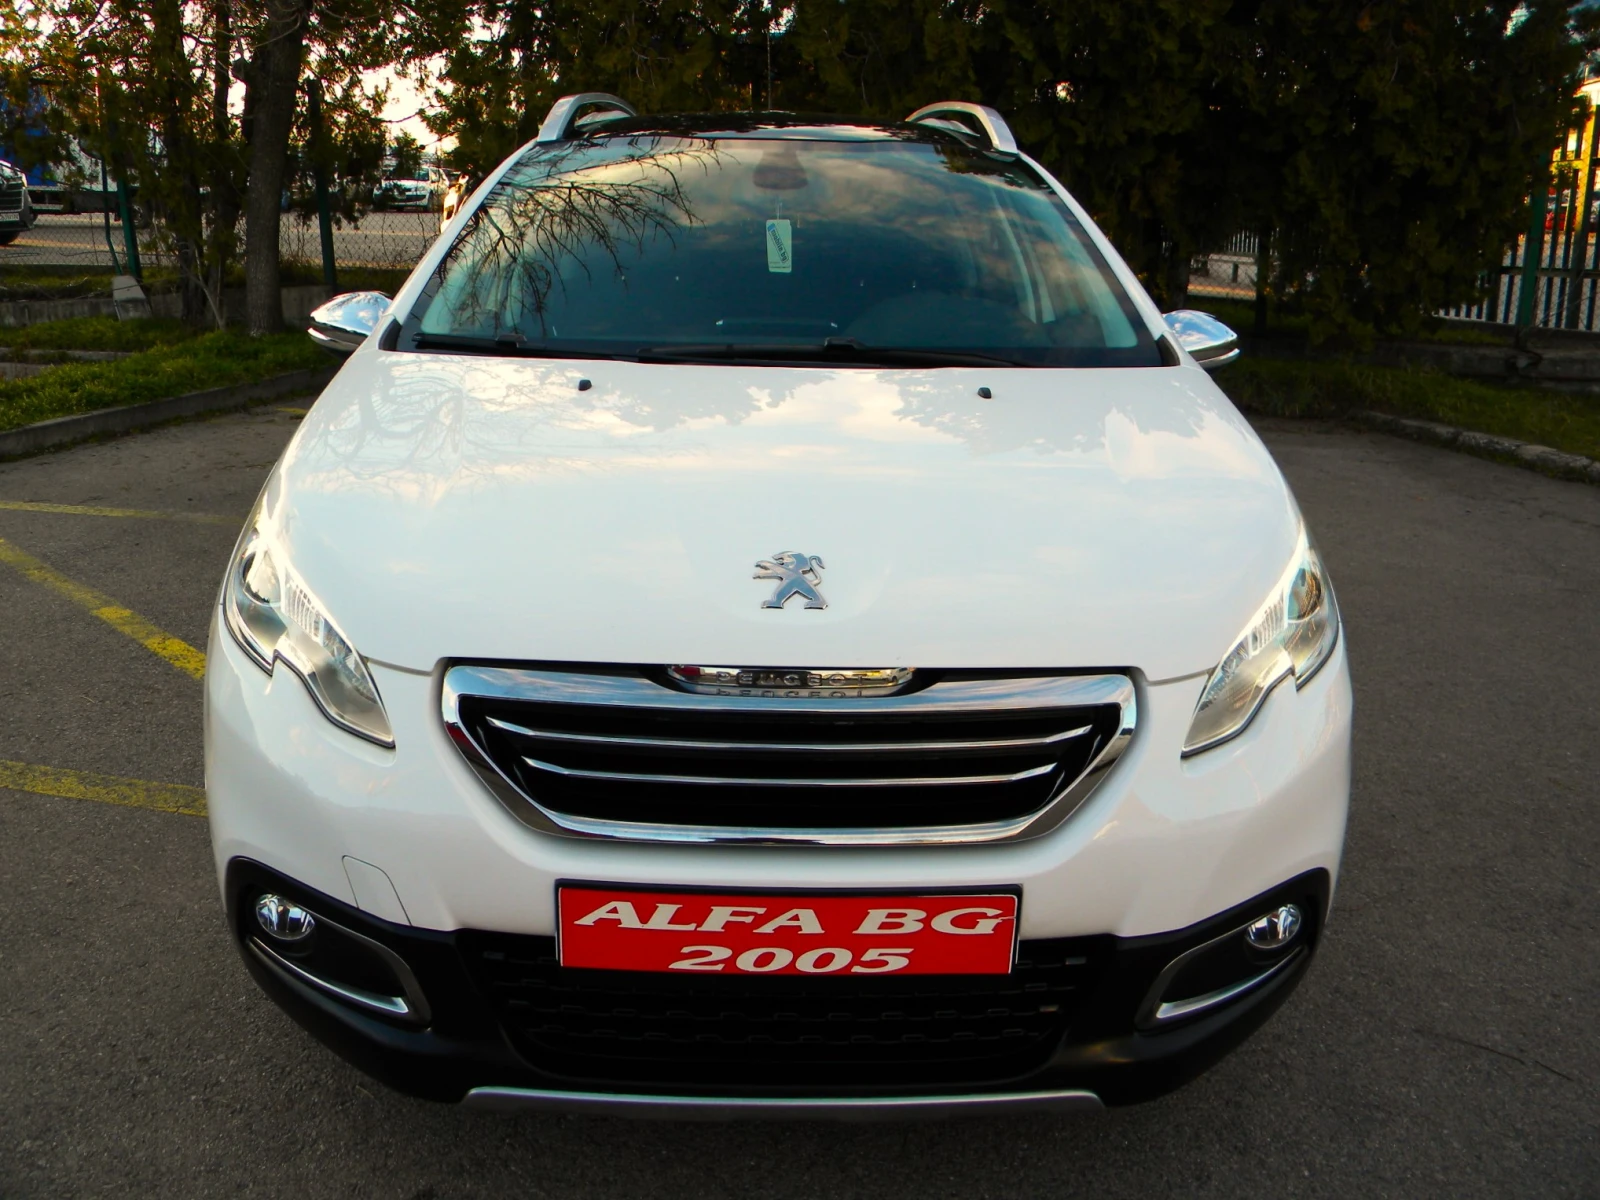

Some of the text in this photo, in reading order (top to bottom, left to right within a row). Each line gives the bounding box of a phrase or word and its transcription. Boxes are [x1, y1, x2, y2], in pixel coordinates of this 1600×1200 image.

[574, 900, 1004, 936] ALFA BG
[668, 945, 915, 974] 2005
